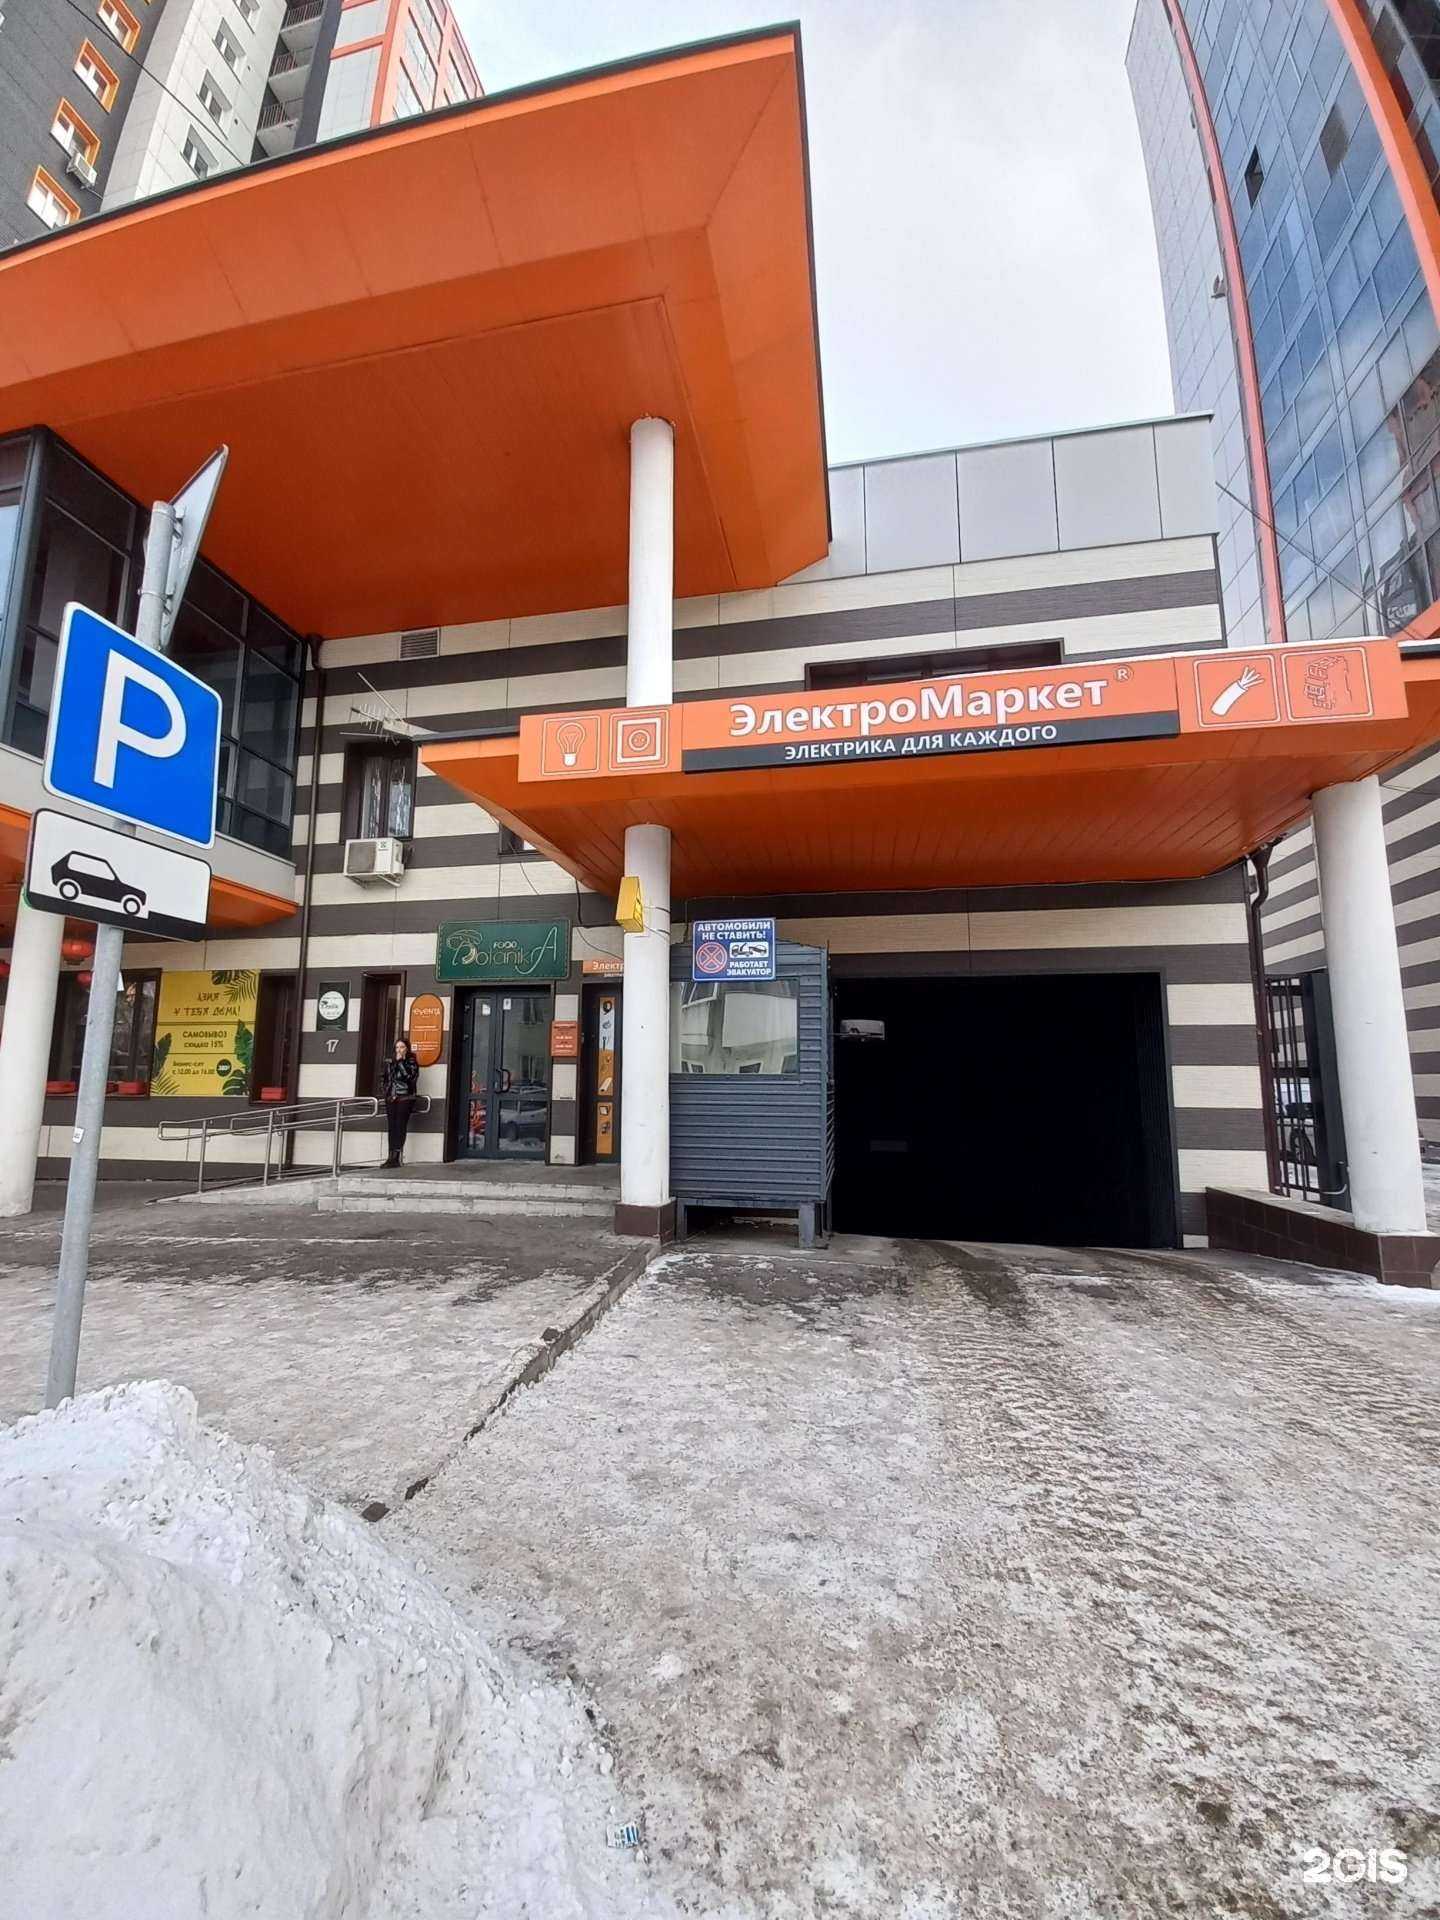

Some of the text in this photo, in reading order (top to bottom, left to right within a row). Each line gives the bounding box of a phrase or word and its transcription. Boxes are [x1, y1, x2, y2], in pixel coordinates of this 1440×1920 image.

[729, 679, 1108, 737] ЭлектроМаркет
[93, 648, 187, 789] P
[784, 724, 1058, 761] ЭЛЕКТРИКА ДЛЯ КАЖДОГО
[697, 921, 771, 931] АВТОМОБИЛИ
[702, 931, 766, 940] НЕ СТАВИТЬ!
[493, 940, 518, 949] FOOD
[592, 960, 624, 973] Электр
[729, 960, 769, 968] РАБОТАЕТ
[726, 968, 772, 976] ЭВАКУАТОР
[182, 1030, 228, 1039] САМОВЫВОЗ
[211, 1040, 224, 1049] 15%
[325, 1039, 339, 1053] 17
